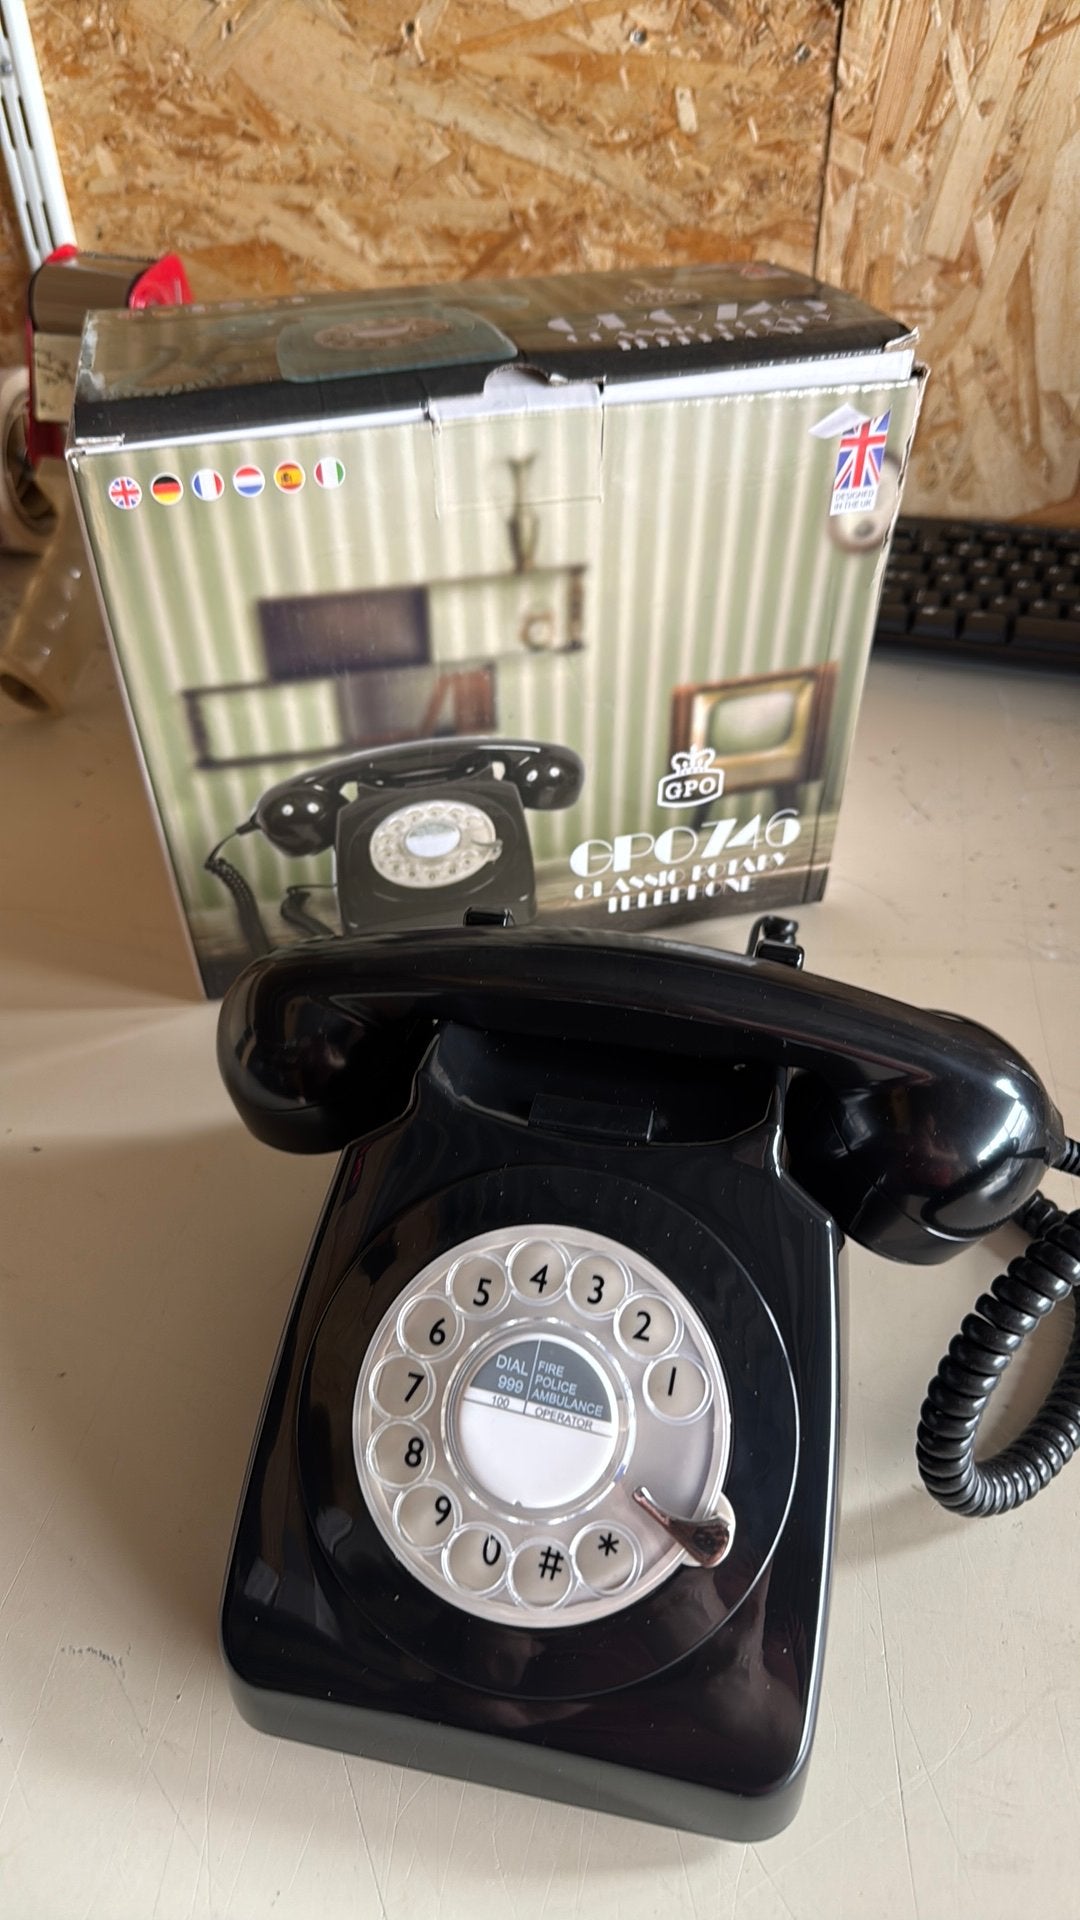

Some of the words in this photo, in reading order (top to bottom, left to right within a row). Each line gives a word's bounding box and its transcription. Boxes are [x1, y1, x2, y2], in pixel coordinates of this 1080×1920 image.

[835, 489, 875, 501] DESIGNED
[665, 777, 716, 800] GPO
[574, 868, 686, 901] CLASSIC
[691, 851, 789, 883] ROTARY
[607, 874, 756, 914] TELEPHONE
[472, 1277, 492, 1307] 5
[530, 1265, 548, 1294] 4
[586, 1274, 605, 1305] 3
[428, 1317, 446, 1346] 6
[632, 1311, 651, 1342] 2
[495, 1353, 529, 1377] DIAL
[537, 1360, 565, 1378] FIRE
[404, 1371, 425, 1403] 7
[497, 1374, 524, 1394] 999
[534, 1376, 578, 1396] POLICE
[667, 1366, 677, 1397] 1
[491, 1394, 510, 1409] 100
[534, 1406, 593, 1431] OPERATOR
[531, 1388, 604, 1417] AMBULANCE
[404, 1436, 425, 1469] 8
[434, 1495, 452, 1526] 9
[482, 1534, 502, 1567] 0
[538, 1546, 564, 1581] #
